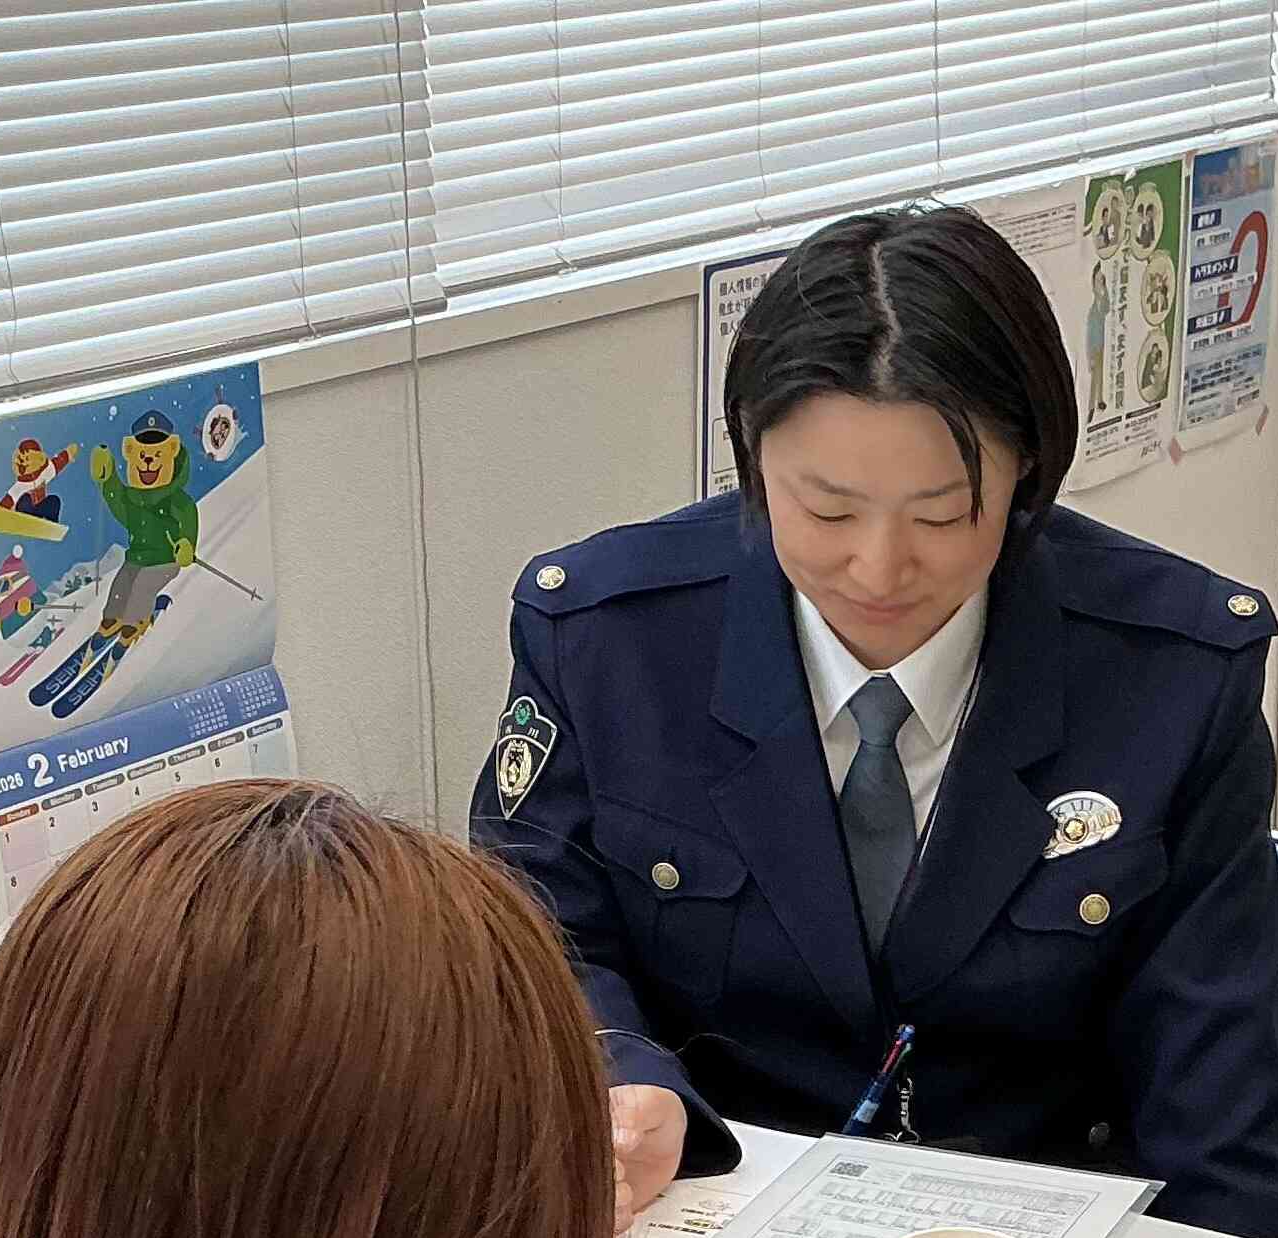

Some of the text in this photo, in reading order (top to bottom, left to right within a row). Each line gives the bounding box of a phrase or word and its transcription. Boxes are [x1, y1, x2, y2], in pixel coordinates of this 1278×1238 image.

[27, 753, 54, 788] 2
[57, 736, 129, 773] February
[49, 817, 55, 828] 2
[92, 802, 98, 812] 3
[134, 786, 140, 796] 4
[175, 772, 181, 782] 5
[214, 758, 221, 768] 6
[11, 876, 17, 887] 8
